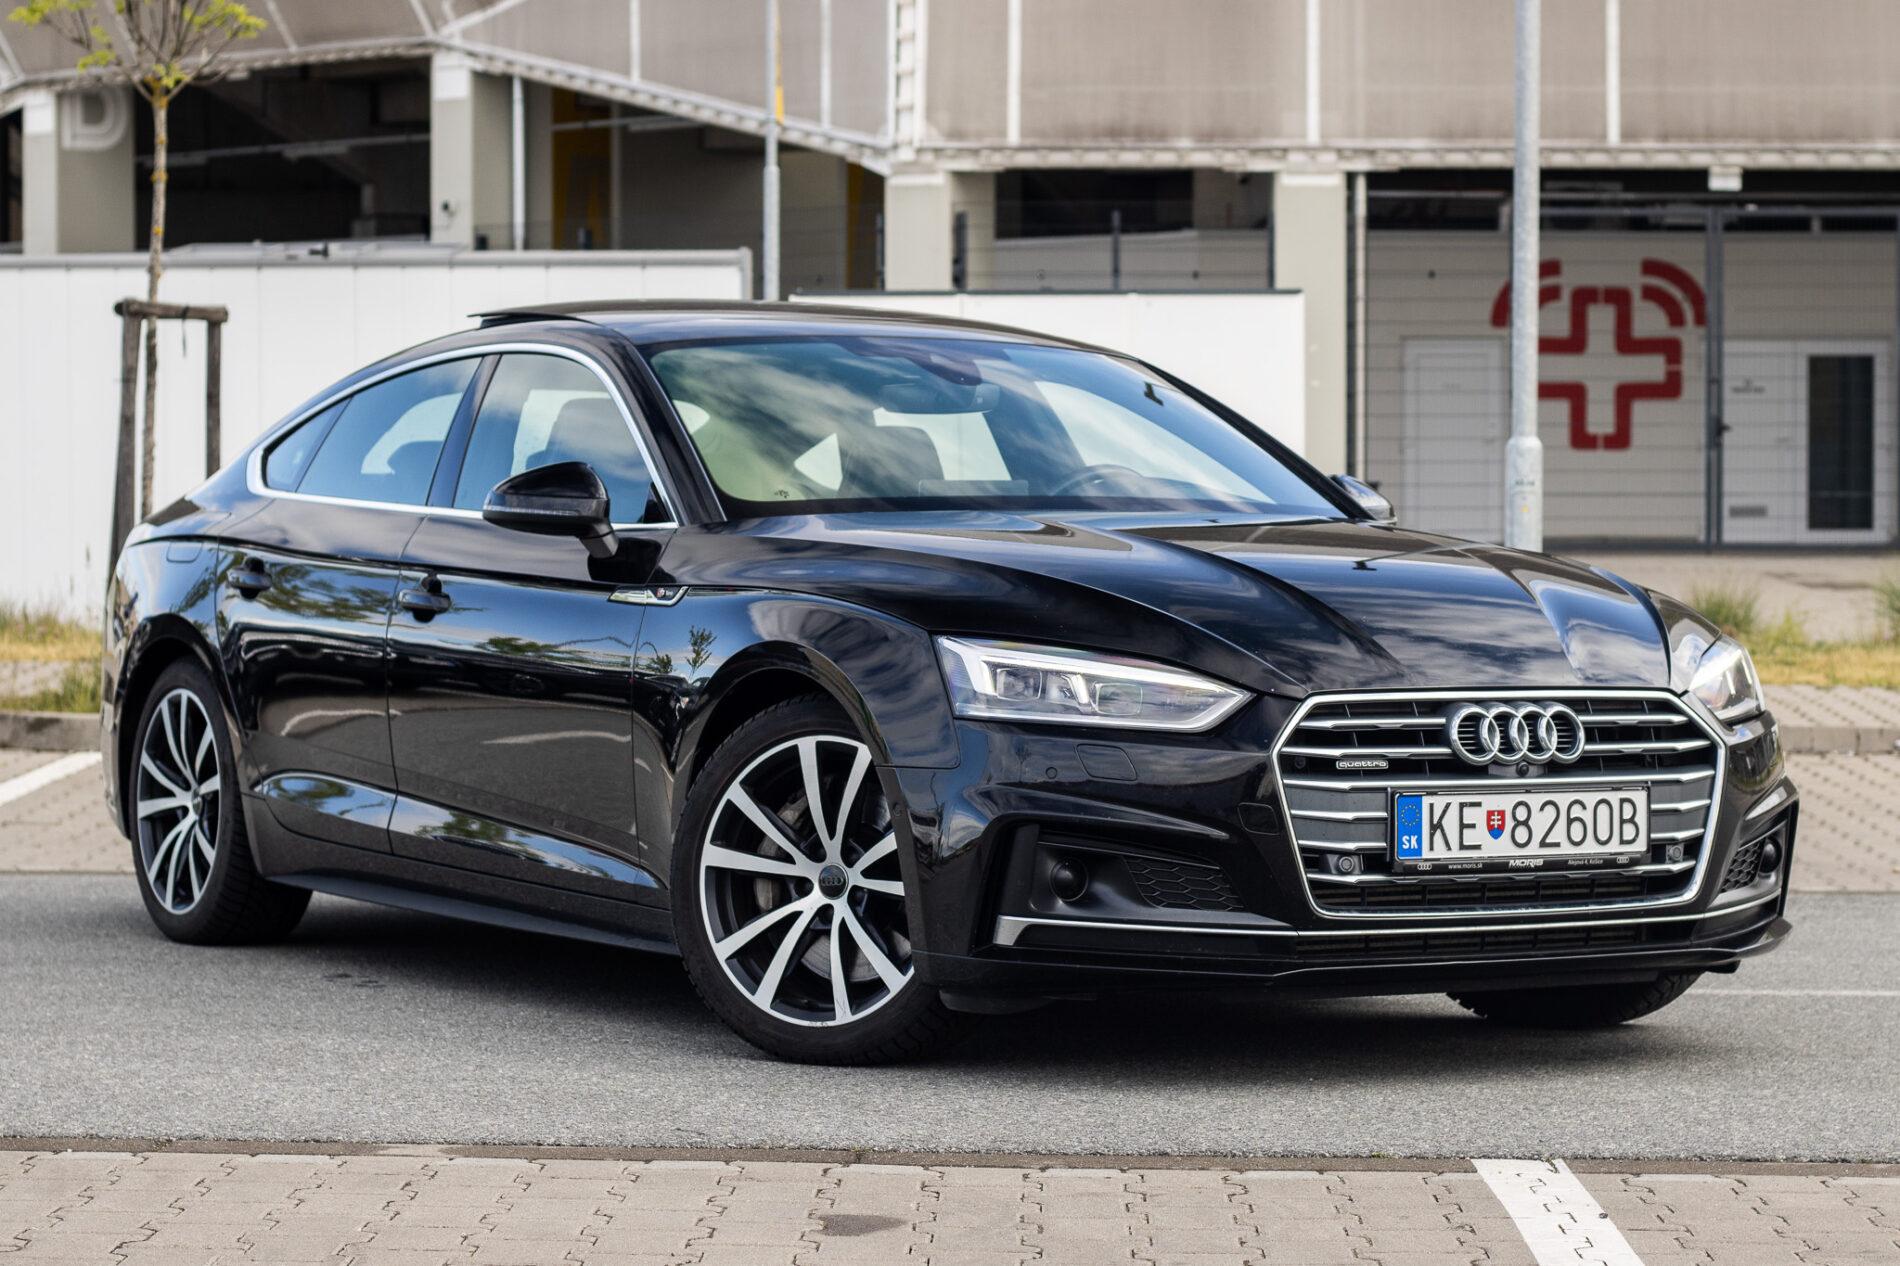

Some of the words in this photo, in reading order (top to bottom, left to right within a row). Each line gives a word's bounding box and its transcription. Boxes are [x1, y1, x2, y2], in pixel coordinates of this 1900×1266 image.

[1339, 760, 1387, 769] quattro
[1428, 801, 1483, 852] KE
[1510, 797, 1640, 849] 8260B
[1402, 835, 1420, 850] SK
[1508, 858, 1544, 868] MORIS
